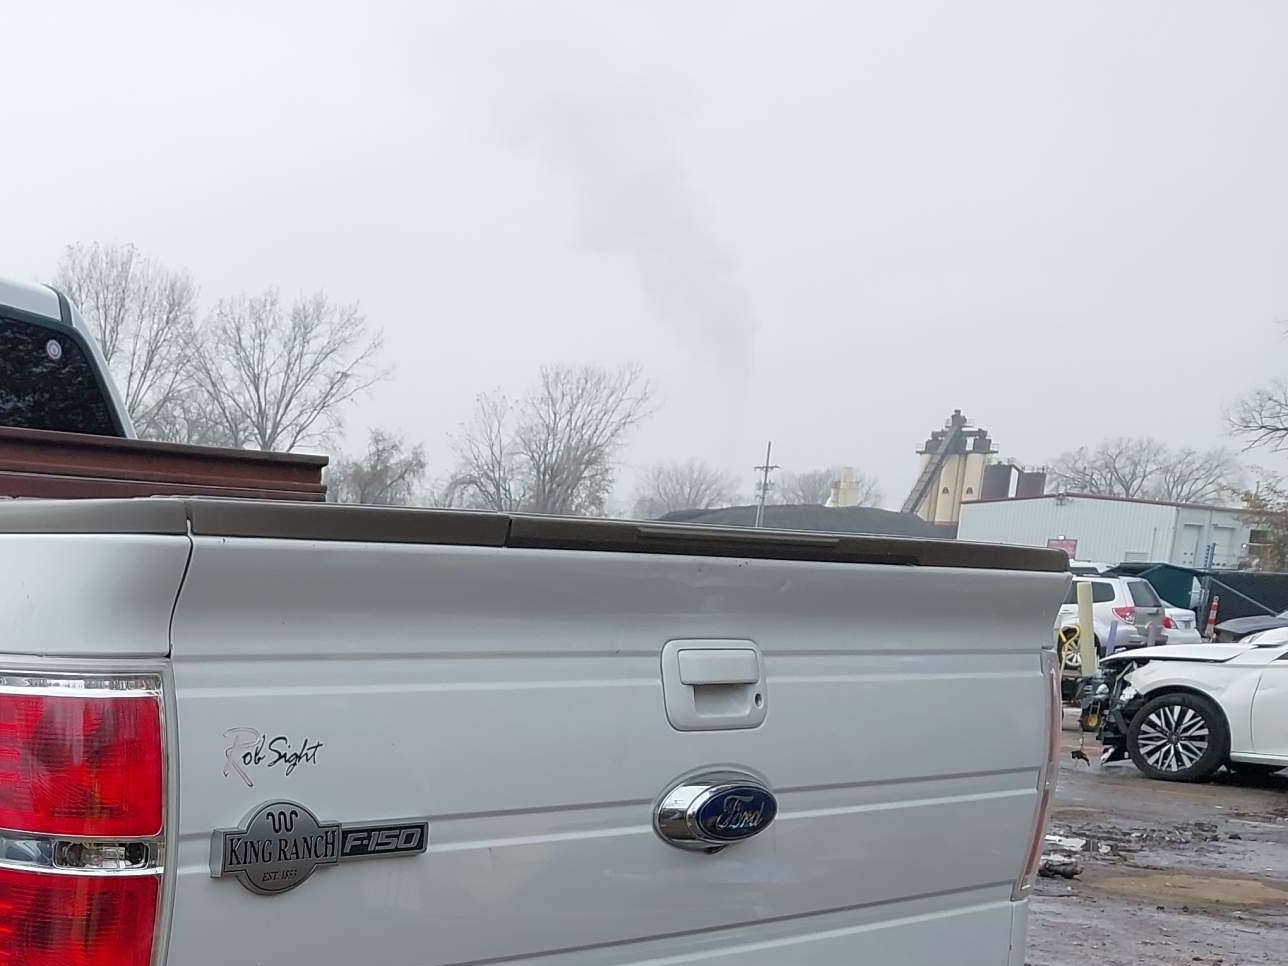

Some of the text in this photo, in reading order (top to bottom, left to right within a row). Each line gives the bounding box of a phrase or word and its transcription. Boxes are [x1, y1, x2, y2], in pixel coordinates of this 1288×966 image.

[222, 727, 324, 787] Rob Sight
[715, 795, 766, 830] Ford
[228, 830, 337, 866] KING RANCH
[344, 828, 423, 853] F-150
